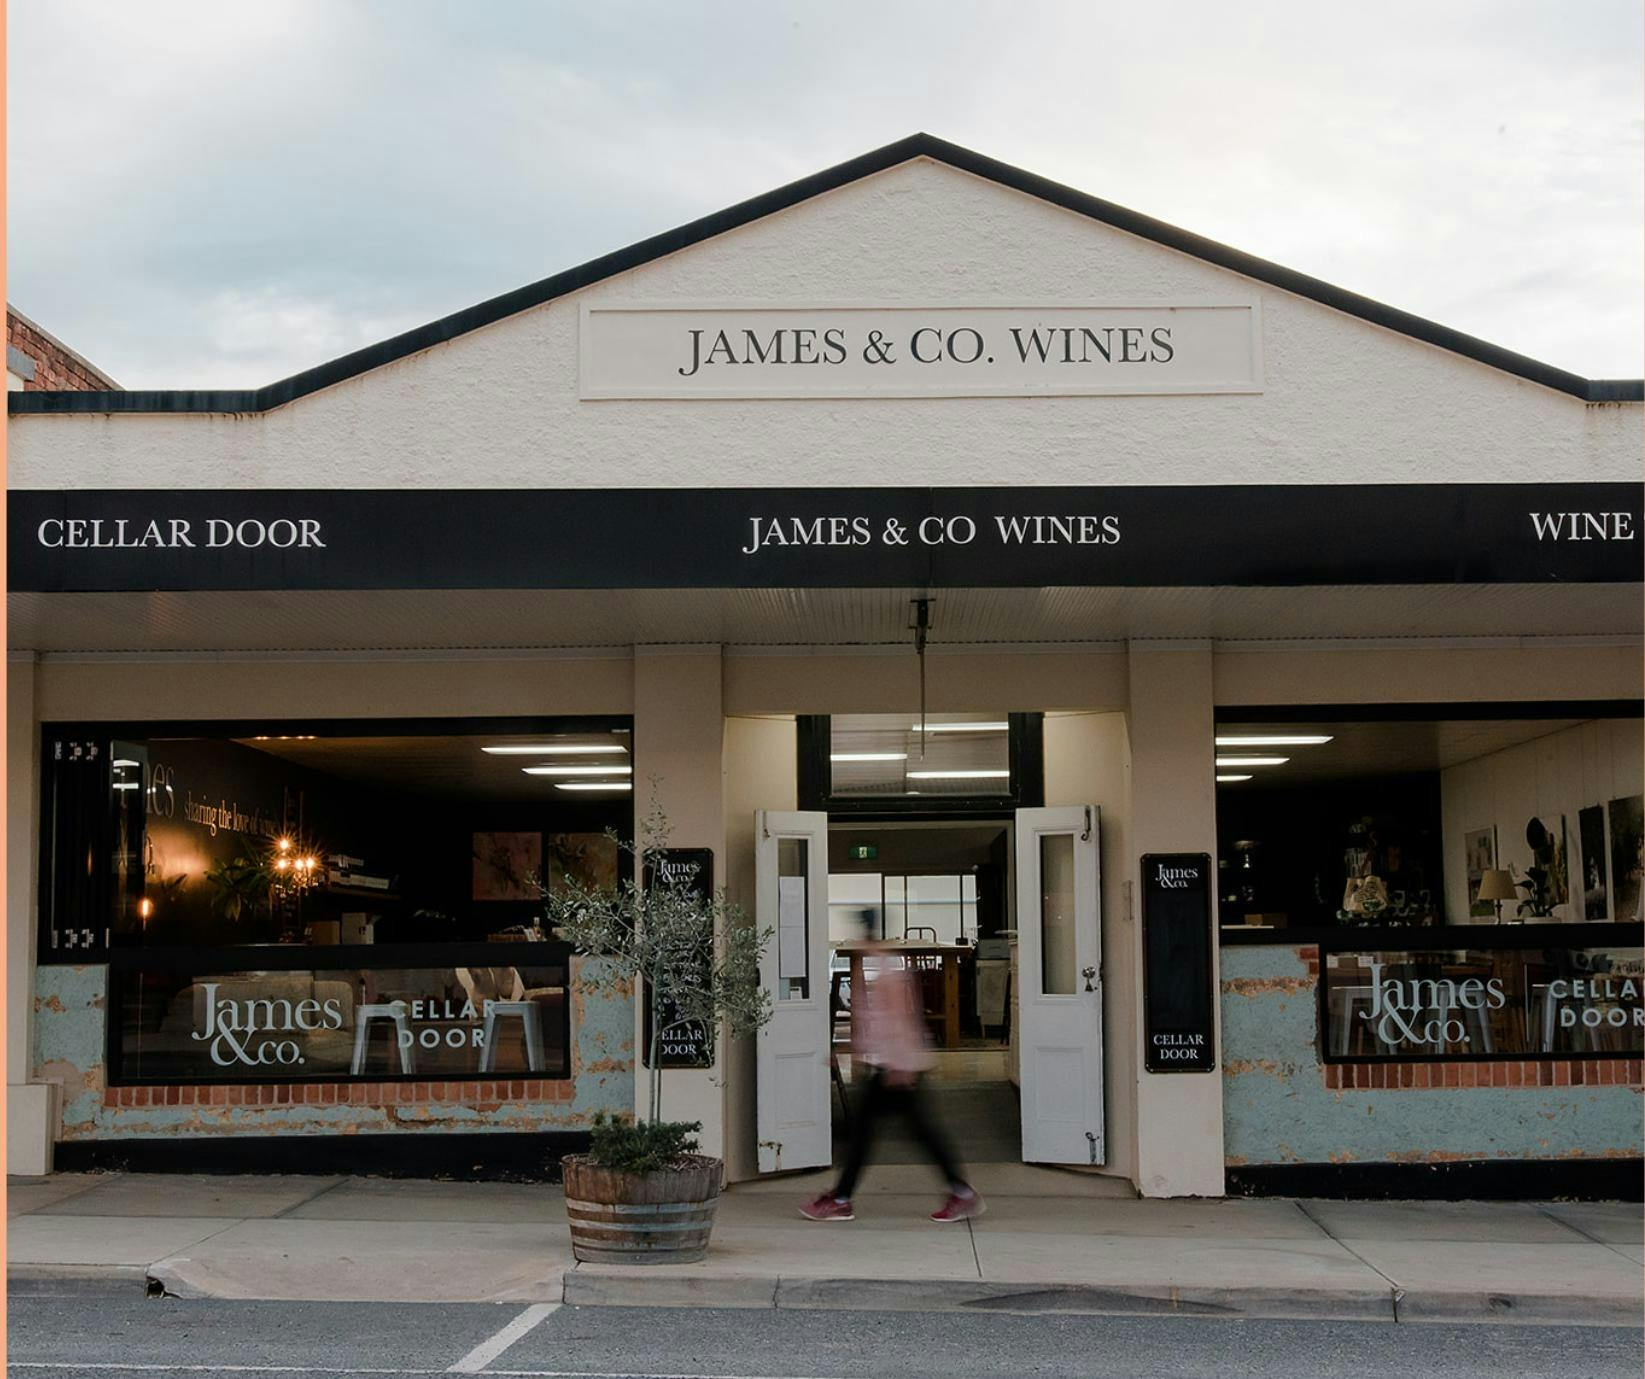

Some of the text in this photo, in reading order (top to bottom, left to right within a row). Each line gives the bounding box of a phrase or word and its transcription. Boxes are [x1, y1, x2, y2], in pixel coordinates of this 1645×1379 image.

[678, 327, 1175, 376] JAMES & CO. WINES
[37, 518, 327, 548] CELLAR DOOR
[742, 515, 1121, 555] JAMES & CO WINES
[1528, 512, 1635, 541] WINE
[184, 790, 217, 837] sharing
[218, 799, 232, 831] the
[1155, 863, 1199, 881] James
[1358, 962, 1506, 1020] James
[191, 983, 343, 1041] James
[1560, 1006, 1643, 1028] DOOR
[210, 1008, 306, 1067] &co.
[398, 1028, 485, 1049] DOOR
[661, 1029, 704, 1041] ELLAR
[1153, 1033, 1205, 1046] CELLAR
[1160, 1048, 1200, 1060] DOOR
